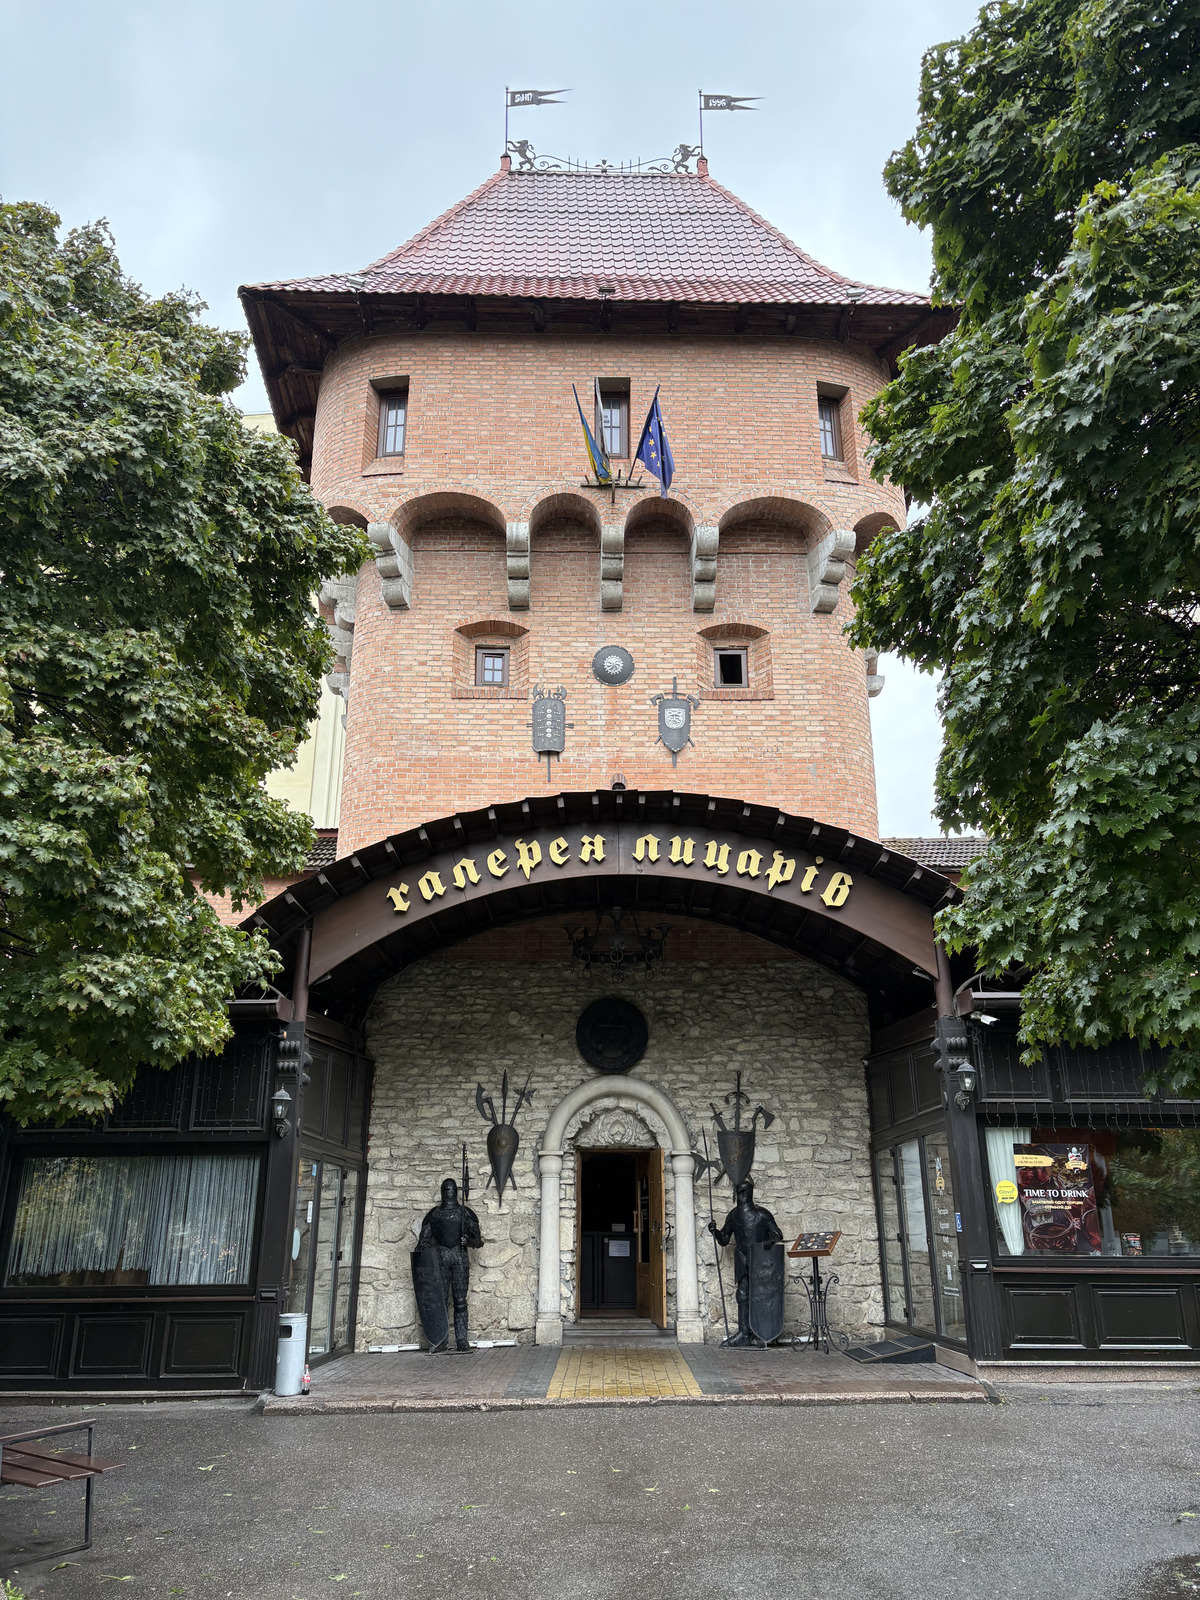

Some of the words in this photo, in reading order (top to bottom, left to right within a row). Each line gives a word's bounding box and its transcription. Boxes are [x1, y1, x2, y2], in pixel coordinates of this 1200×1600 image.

[708, 97, 727, 107] 1996
[386, 833, 606, 912] галерея
[632, 833, 854, 907] лицарів
[1024, 1189, 1046, 1198] TIME
[1047, 1189, 1059, 1198] TO
[1060, 1190, 1088, 1198] DRINK
